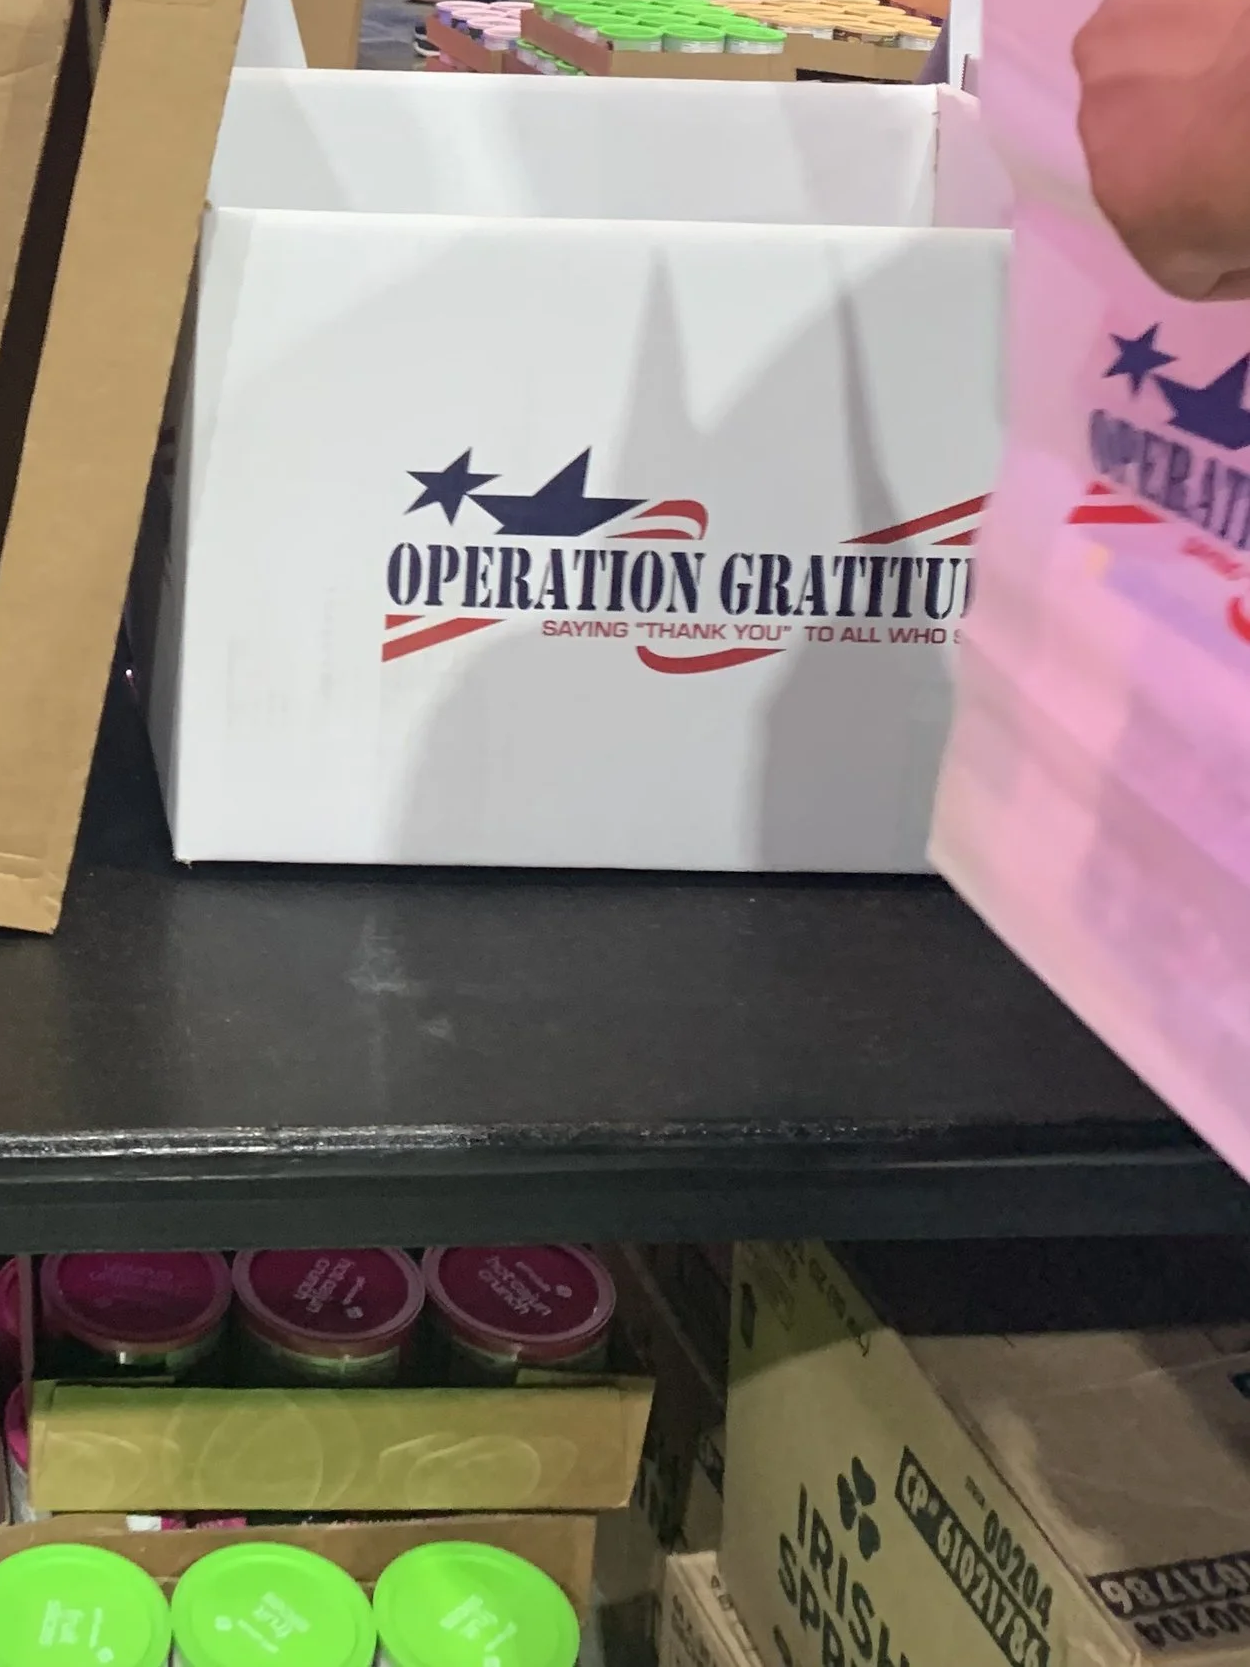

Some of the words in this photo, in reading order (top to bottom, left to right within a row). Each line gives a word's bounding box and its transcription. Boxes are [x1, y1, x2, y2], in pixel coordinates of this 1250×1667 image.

[386, 541, 706, 613] OPERATION
[541, 620, 629, 639] SAYING
[804, 625, 835, 643] TO
[839, 626, 882, 644] ALL
[888, 627, 947, 645] WHO
[983, 1508, 1053, 1633] 00204
